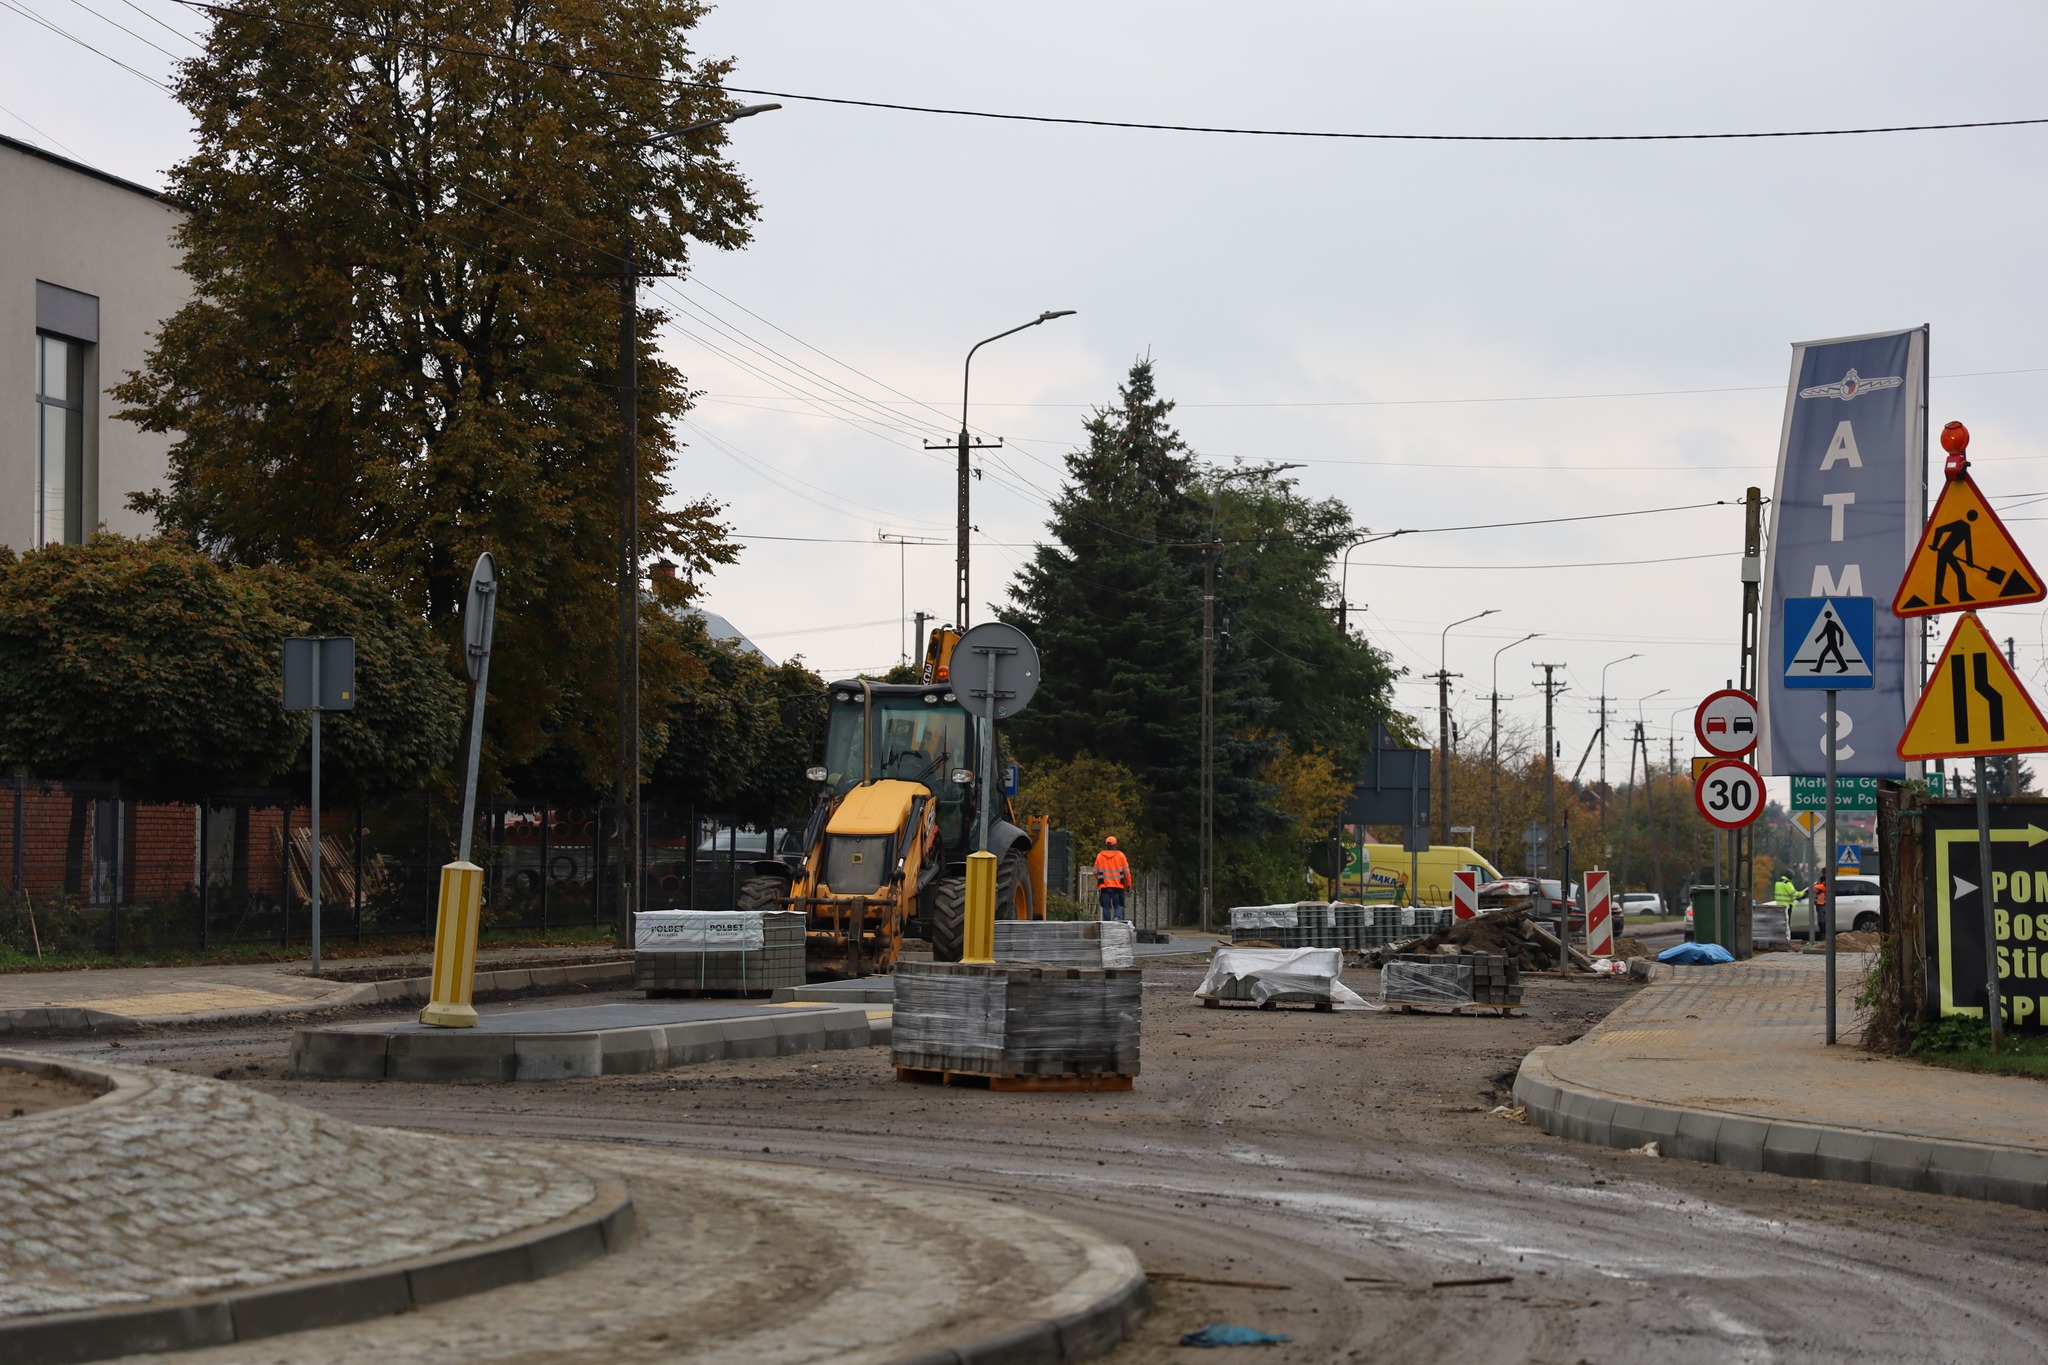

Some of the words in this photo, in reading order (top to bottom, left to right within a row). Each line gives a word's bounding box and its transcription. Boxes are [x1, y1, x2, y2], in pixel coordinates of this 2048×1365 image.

[1794, 776, 1855, 788] Małknia
[1708, 779, 1752, 811] 30
[1794, 792, 1853, 805] Sokoów
[1858, 793, 1877, 805] Po
